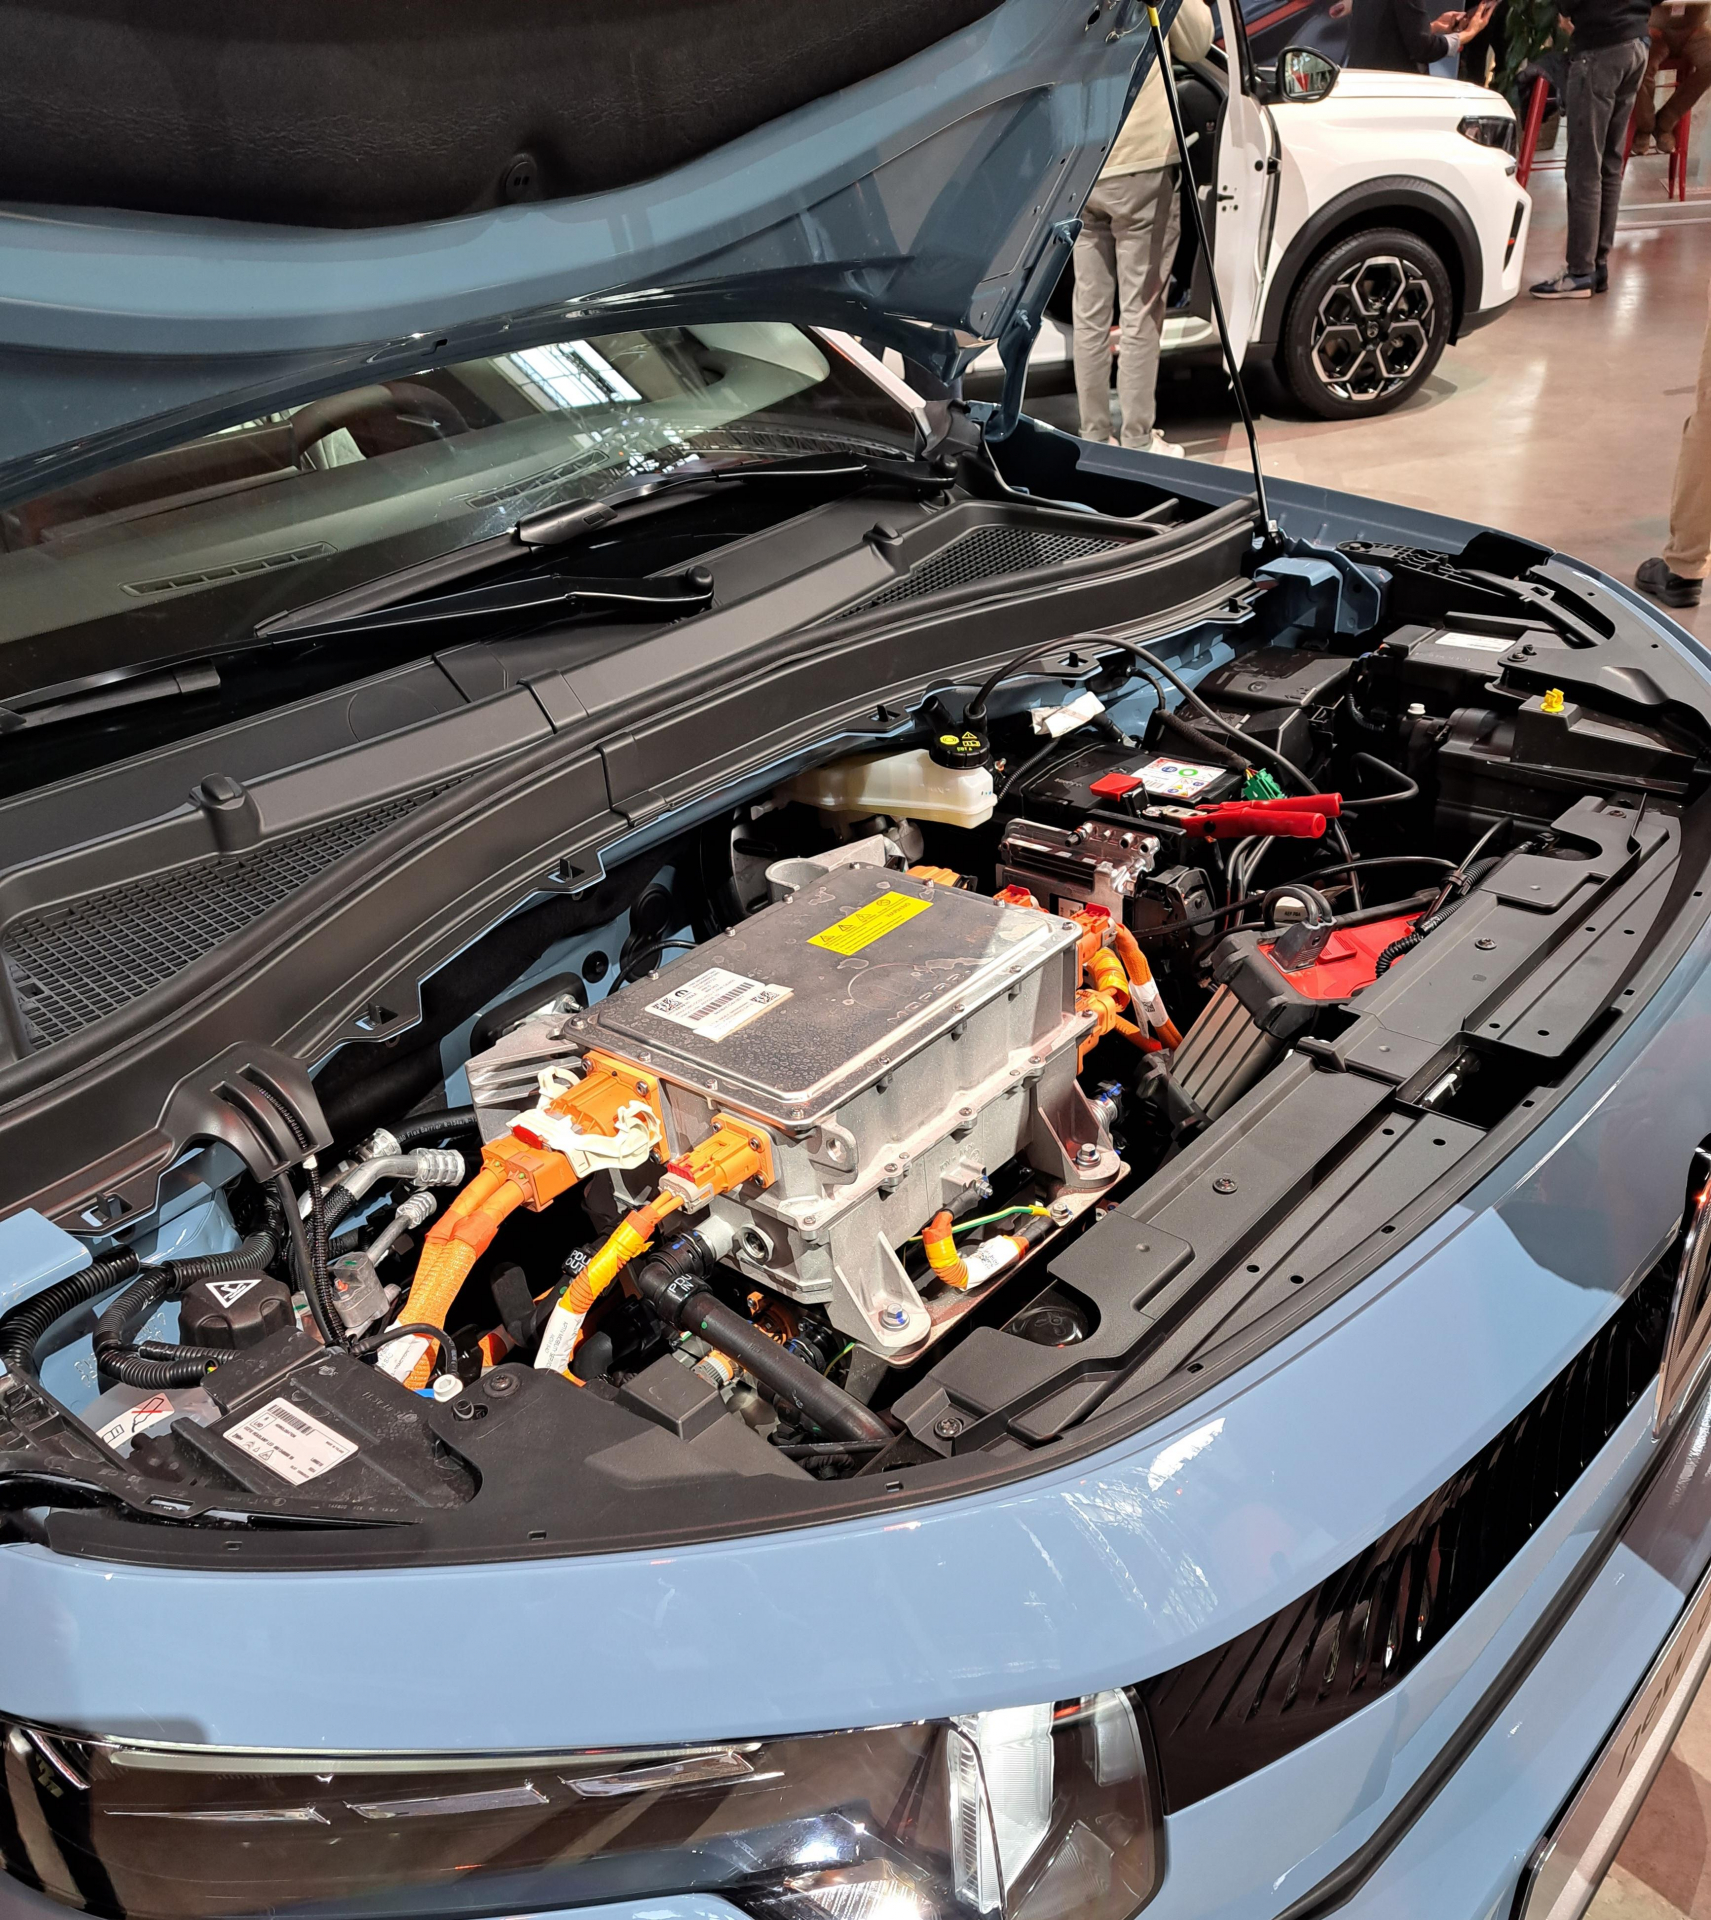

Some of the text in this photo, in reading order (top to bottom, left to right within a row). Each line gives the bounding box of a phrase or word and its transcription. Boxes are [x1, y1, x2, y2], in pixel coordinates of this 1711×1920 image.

[407, 1128, 420, 1138] Flex
[420, 1123, 442, 1133] Barrier
[565, 1257, 587, 1273] OUT
[571, 1249, 591, 1266] PDU
[667, 1273, 692, 1293] PDU
[680, 1281, 694, 1292] IN
[1617, 1630, 1694, 1778] new
